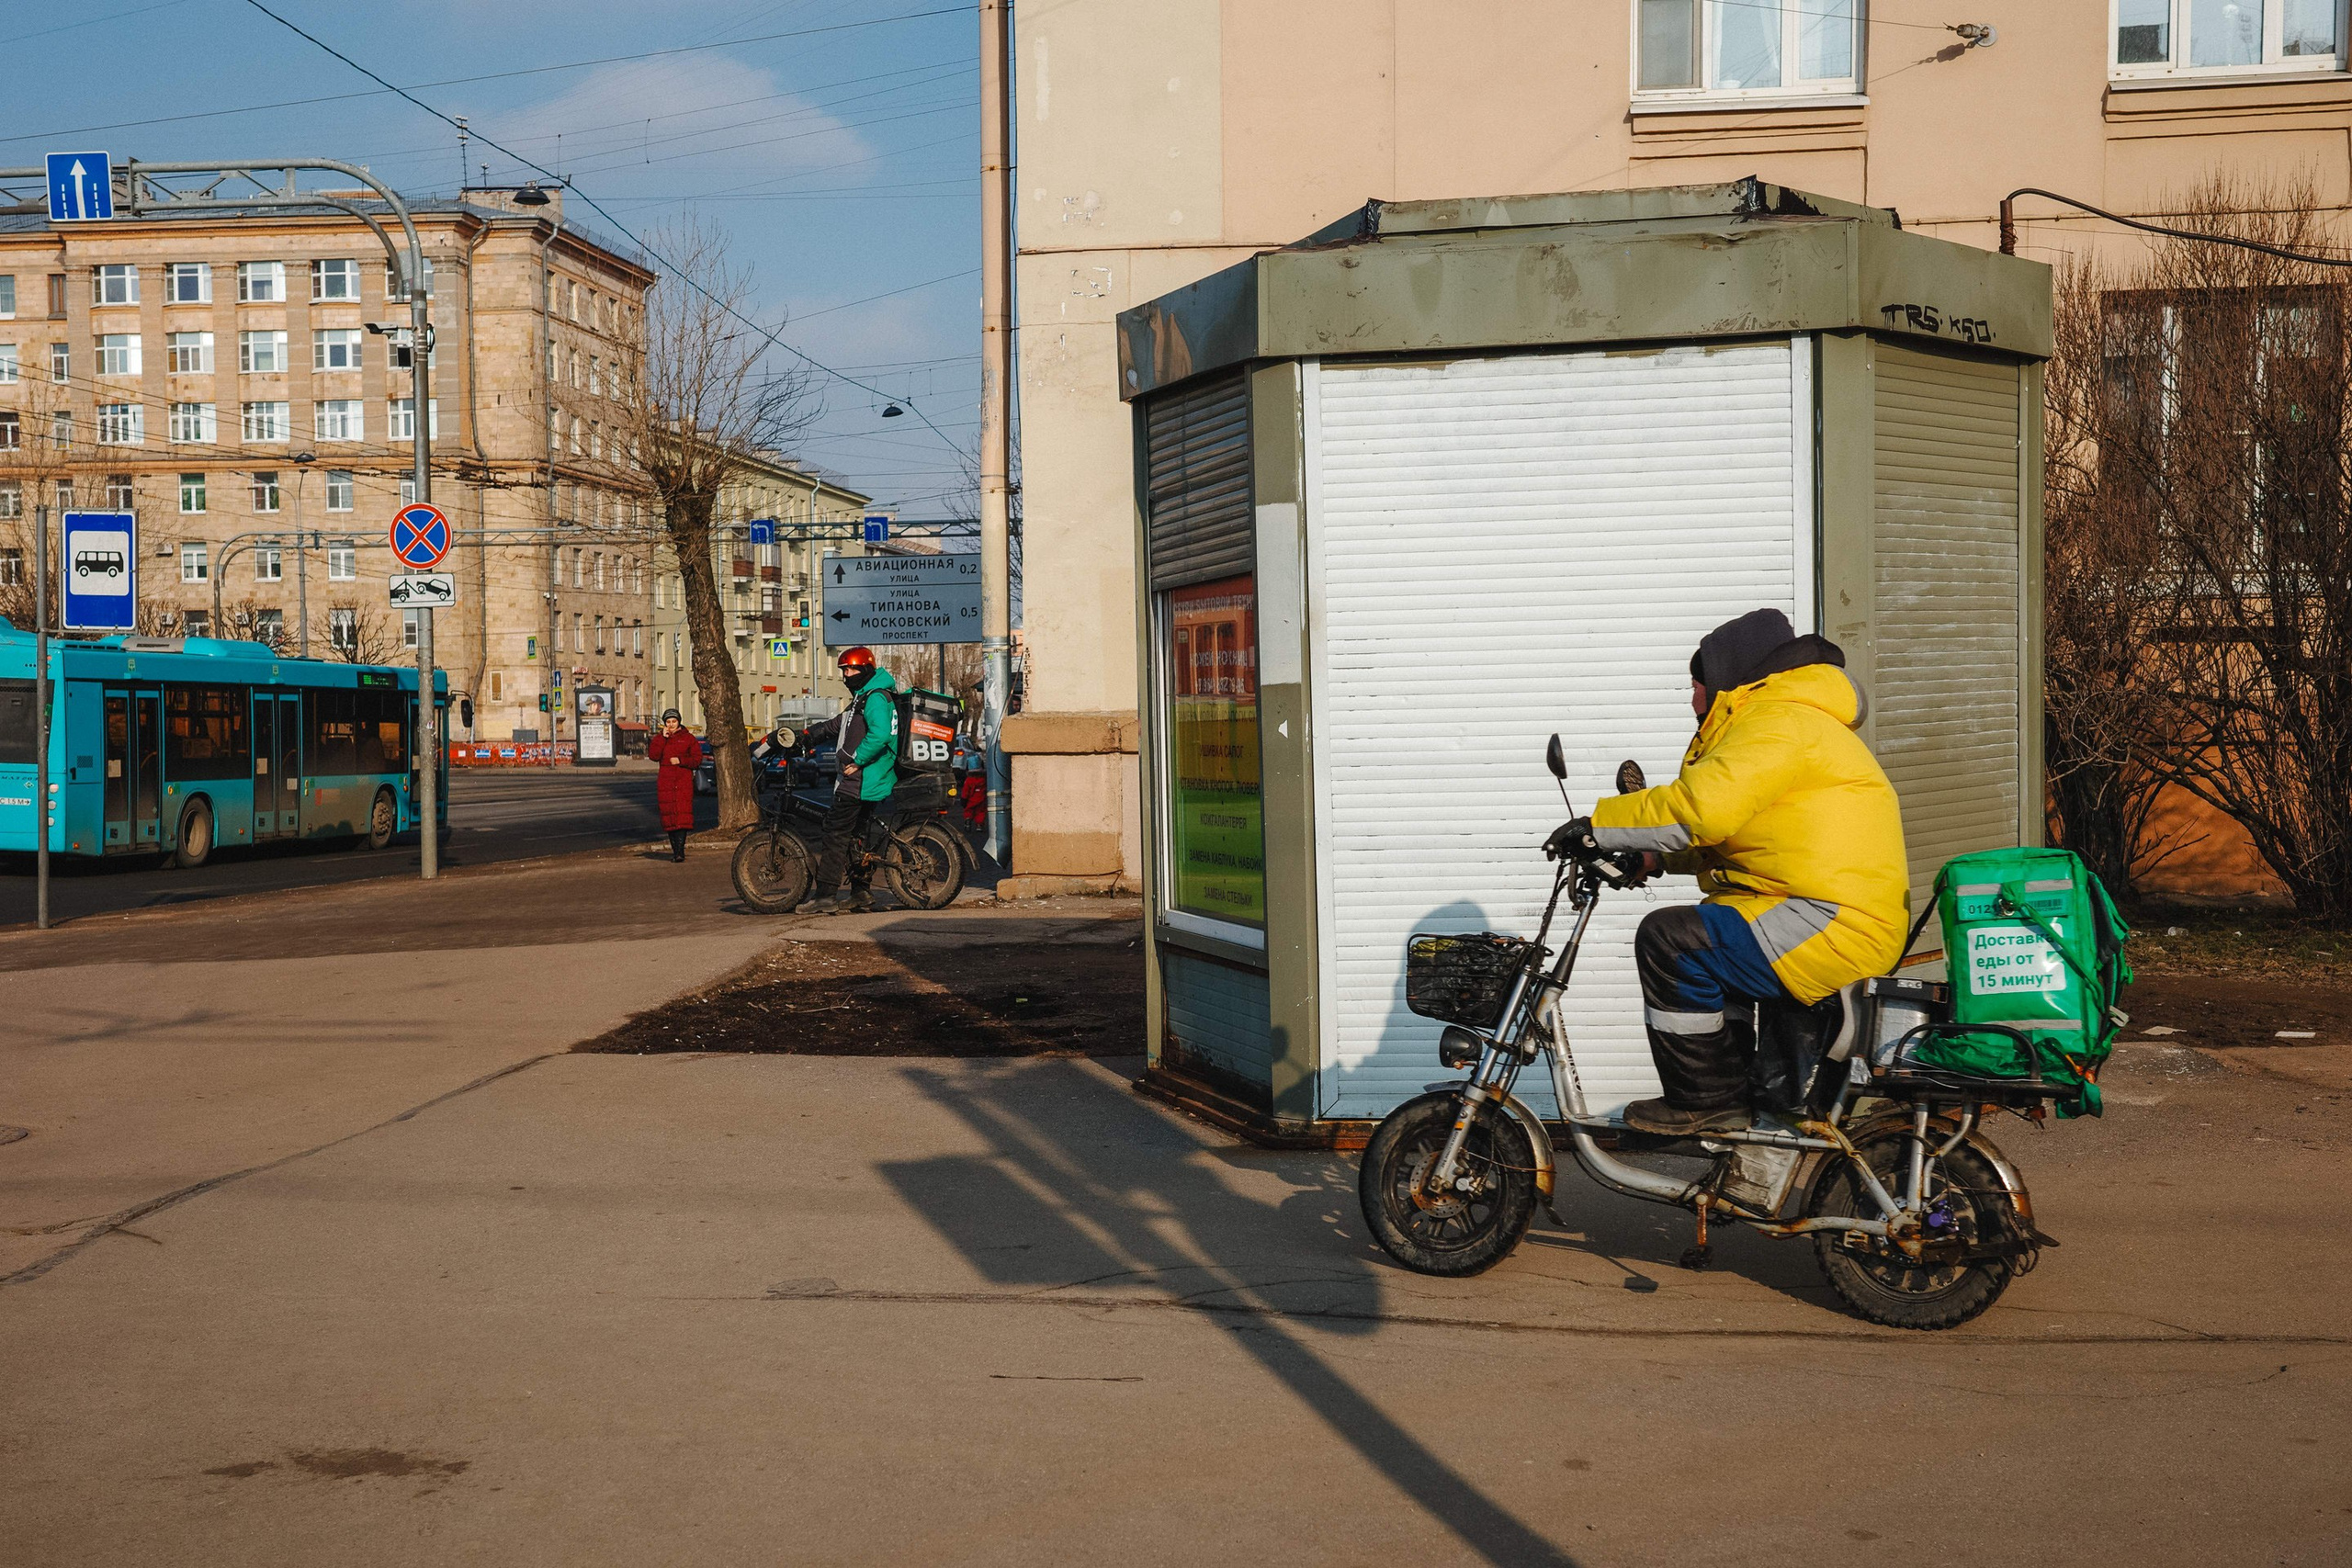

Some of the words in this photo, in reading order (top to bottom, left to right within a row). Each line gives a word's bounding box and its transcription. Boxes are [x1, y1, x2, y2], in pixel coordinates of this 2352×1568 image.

[855, 558, 955, 572] АВИАЦИОННАЯ
[959, 563, 978, 576] 0,2
[889, 575, 920, 583] УЛИЦА
[889, 590, 921, 598] УЛИЦА
[870, 600, 941, 613] ТИПАНОВА
[960, 607, 978, 619] 0,5
[861, 614, 951, 628] МОСКОВСКИЙ
[882, 632, 928, 640] ПРОСПЕКТ
[1976, 956, 2010, 970] еды
[2016, 954, 2034, 965] от
[1977, 974, 1996, 988] 15
[2001, 974, 2052, 988] минут
